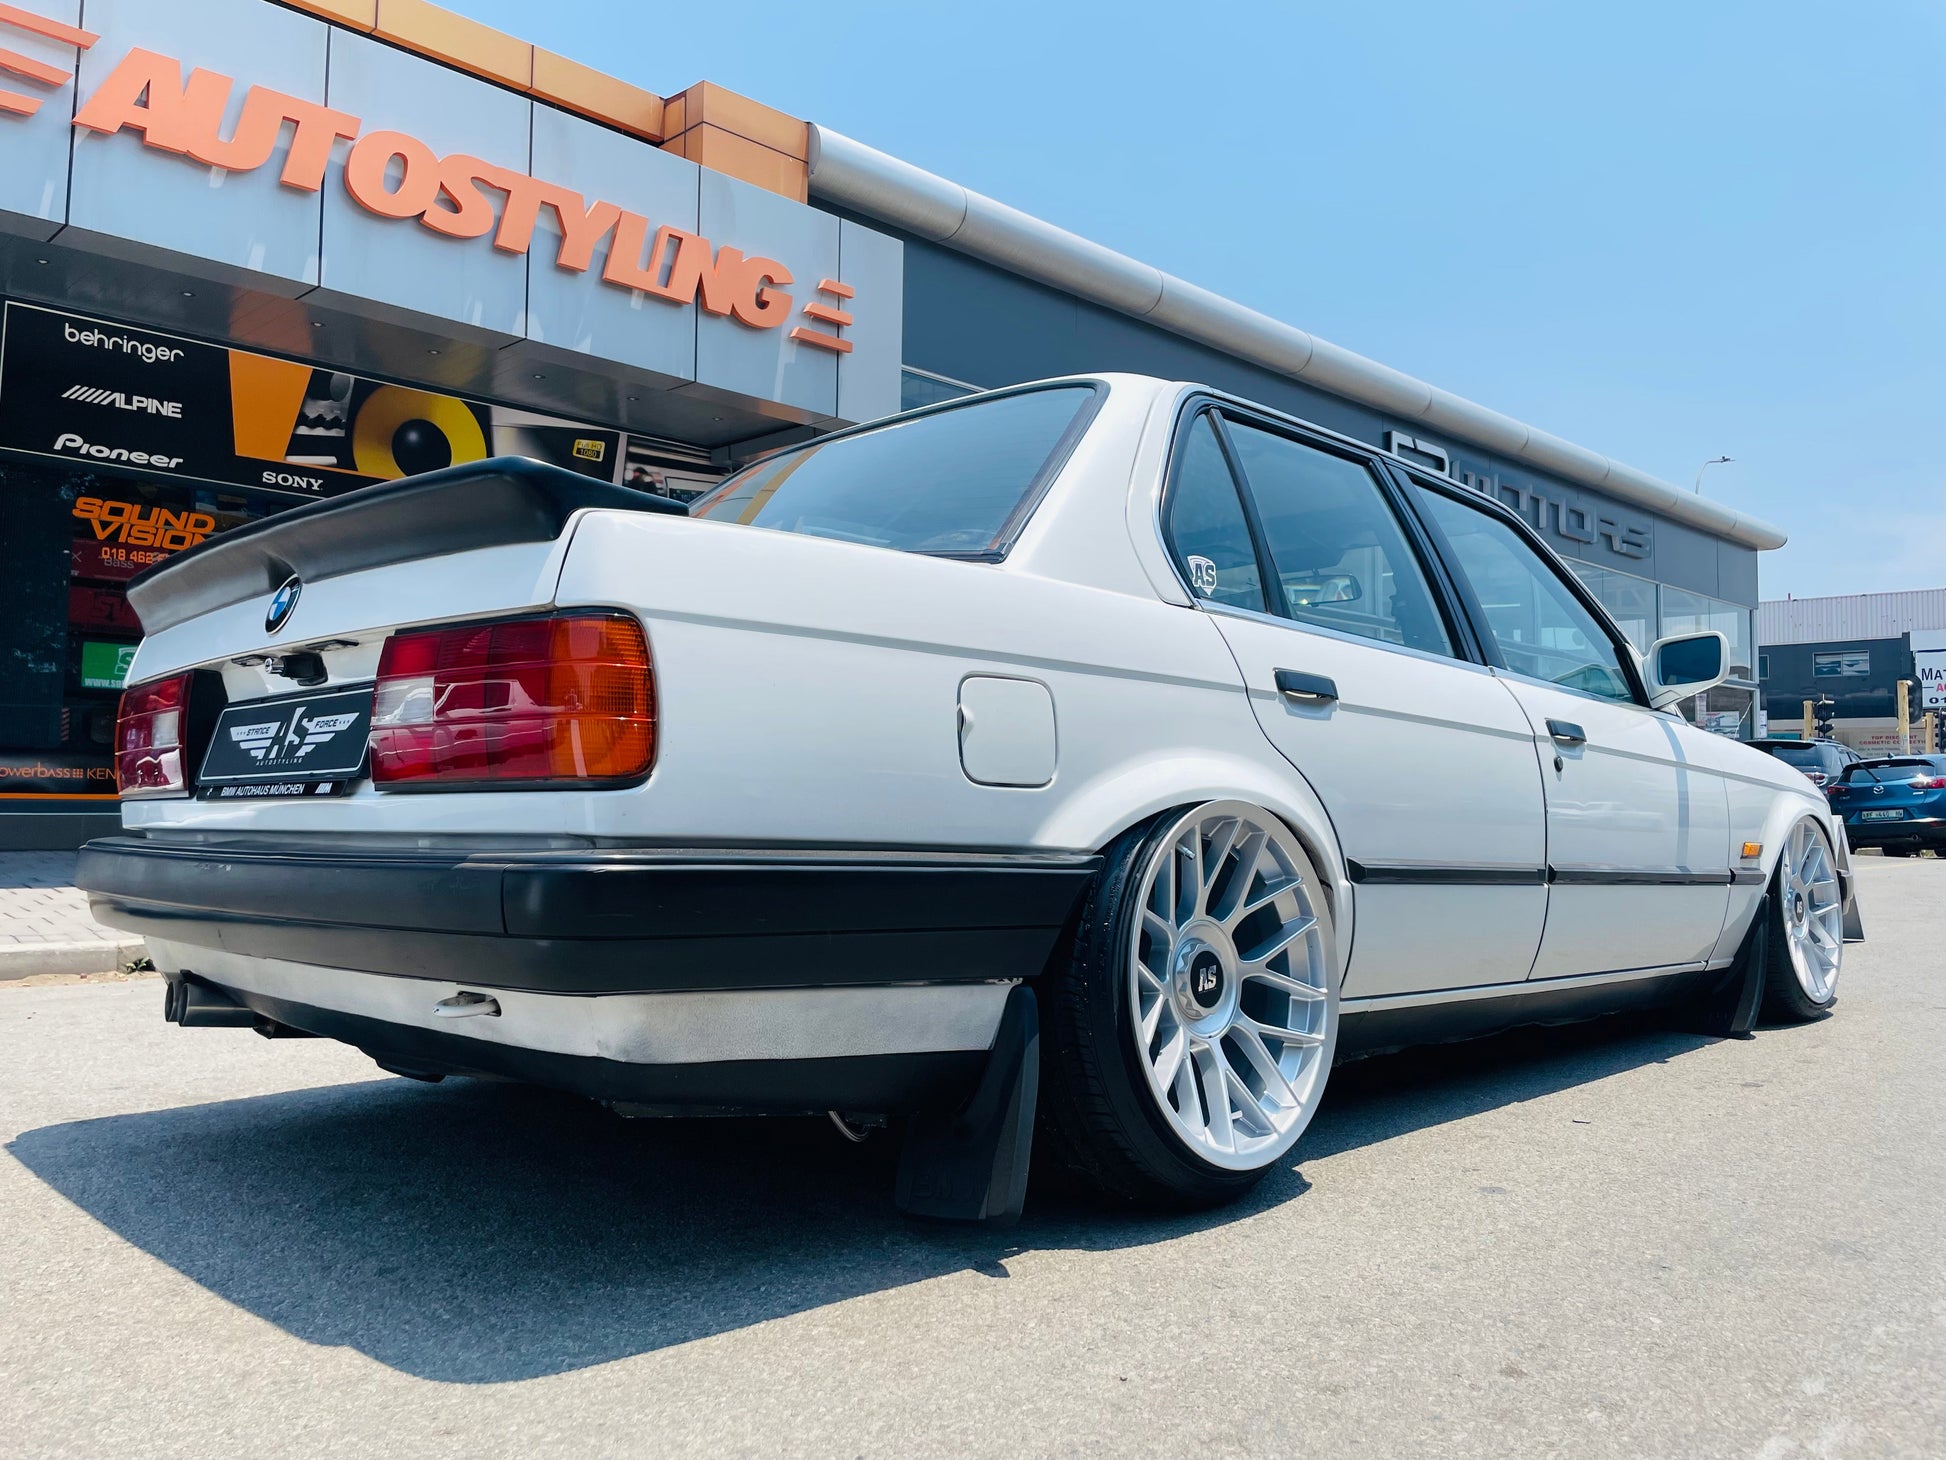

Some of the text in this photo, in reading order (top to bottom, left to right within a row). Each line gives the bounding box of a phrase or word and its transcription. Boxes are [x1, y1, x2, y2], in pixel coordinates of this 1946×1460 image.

[73, 47, 794, 329] AUTOSTYLING
[64, 322, 185, 363] behringer
[53, 432, 184, 469] Pioneer
[580, 449, 597, 458] 1080
[262, 470, 324, 491] SONY
[72, 496, 216, 534] SOUND
[101, 547, 126, 561] 018
[130, 550, 154, 564] 462
[1192, 561, 1217, 588] AS
[84, 677, 125, 689] www.so
[314, 718, 338, 729] FORCE
[256, 757, 303, 766] AUTOSTYLING
[220, 786, 238, 797] BMW
[236, 784, 271, 796] AUTOHAUS
[268, 782, 306, 795] MÜNCHEN
[1198, 964, 1217, 992] AS
